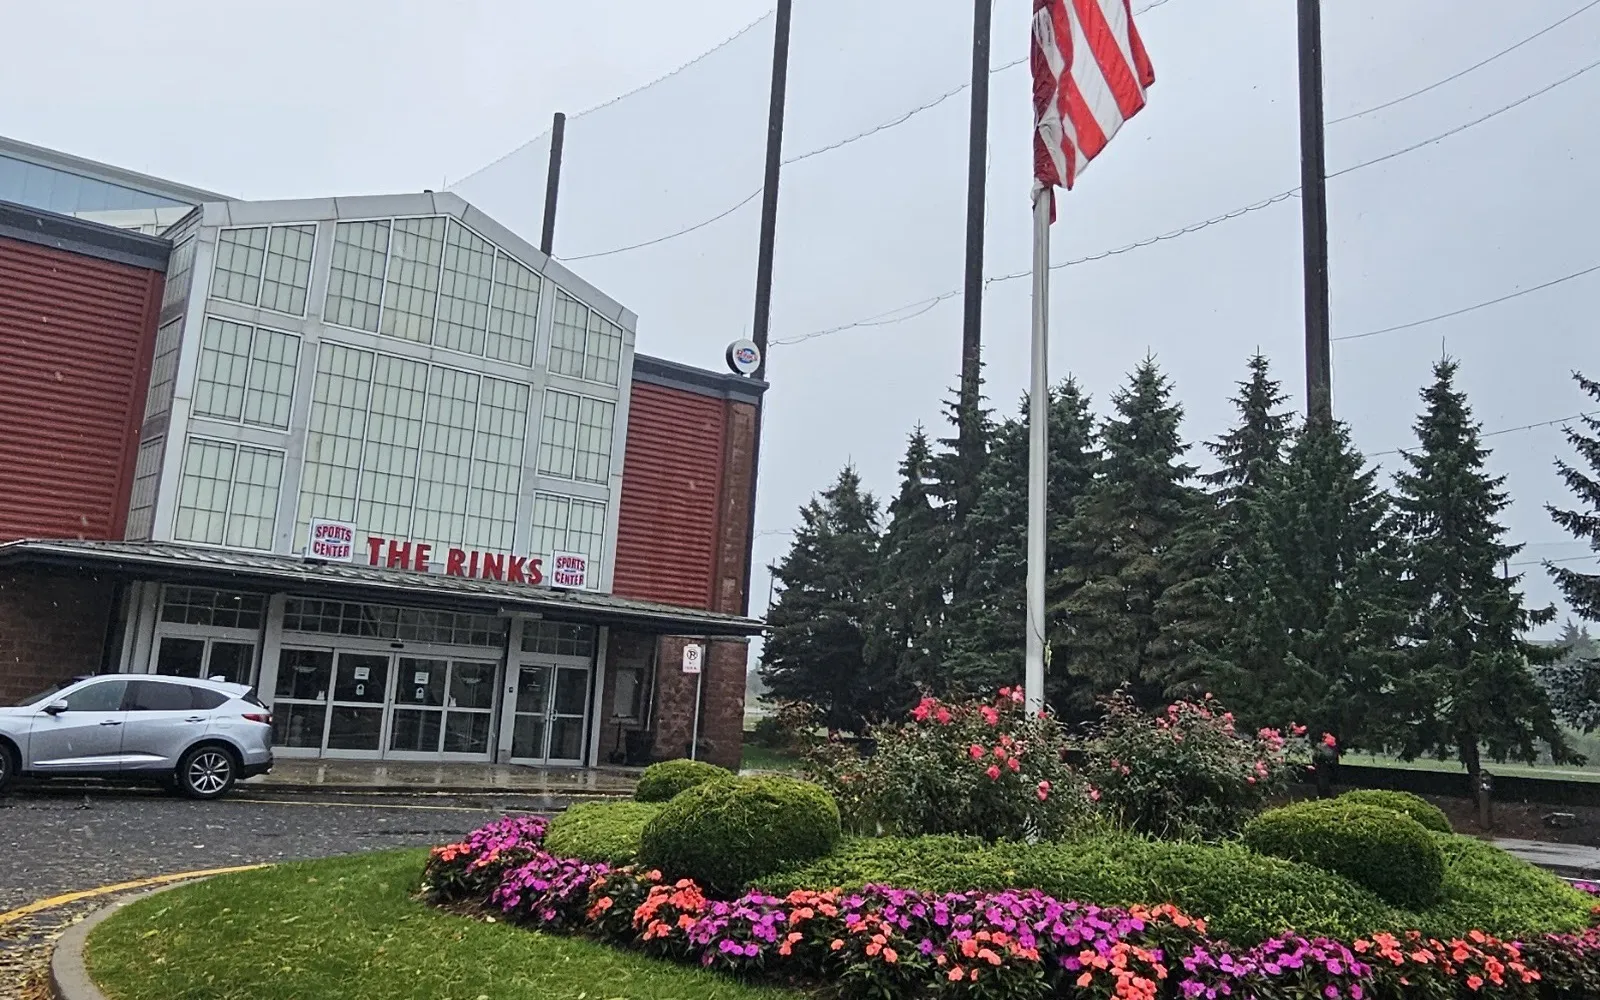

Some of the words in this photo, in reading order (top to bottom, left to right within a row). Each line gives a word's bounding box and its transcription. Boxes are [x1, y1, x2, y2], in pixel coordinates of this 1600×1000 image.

[315, 525, 352, 542] SPORTS
[313, 541, 350, 557] CENTER
[367, 537, 432, 573] THE
[446, 548, 543, 585] RINKS
[556, 556, 586, 571] SPORTS
[555, 571, 584, 586] CENTER
